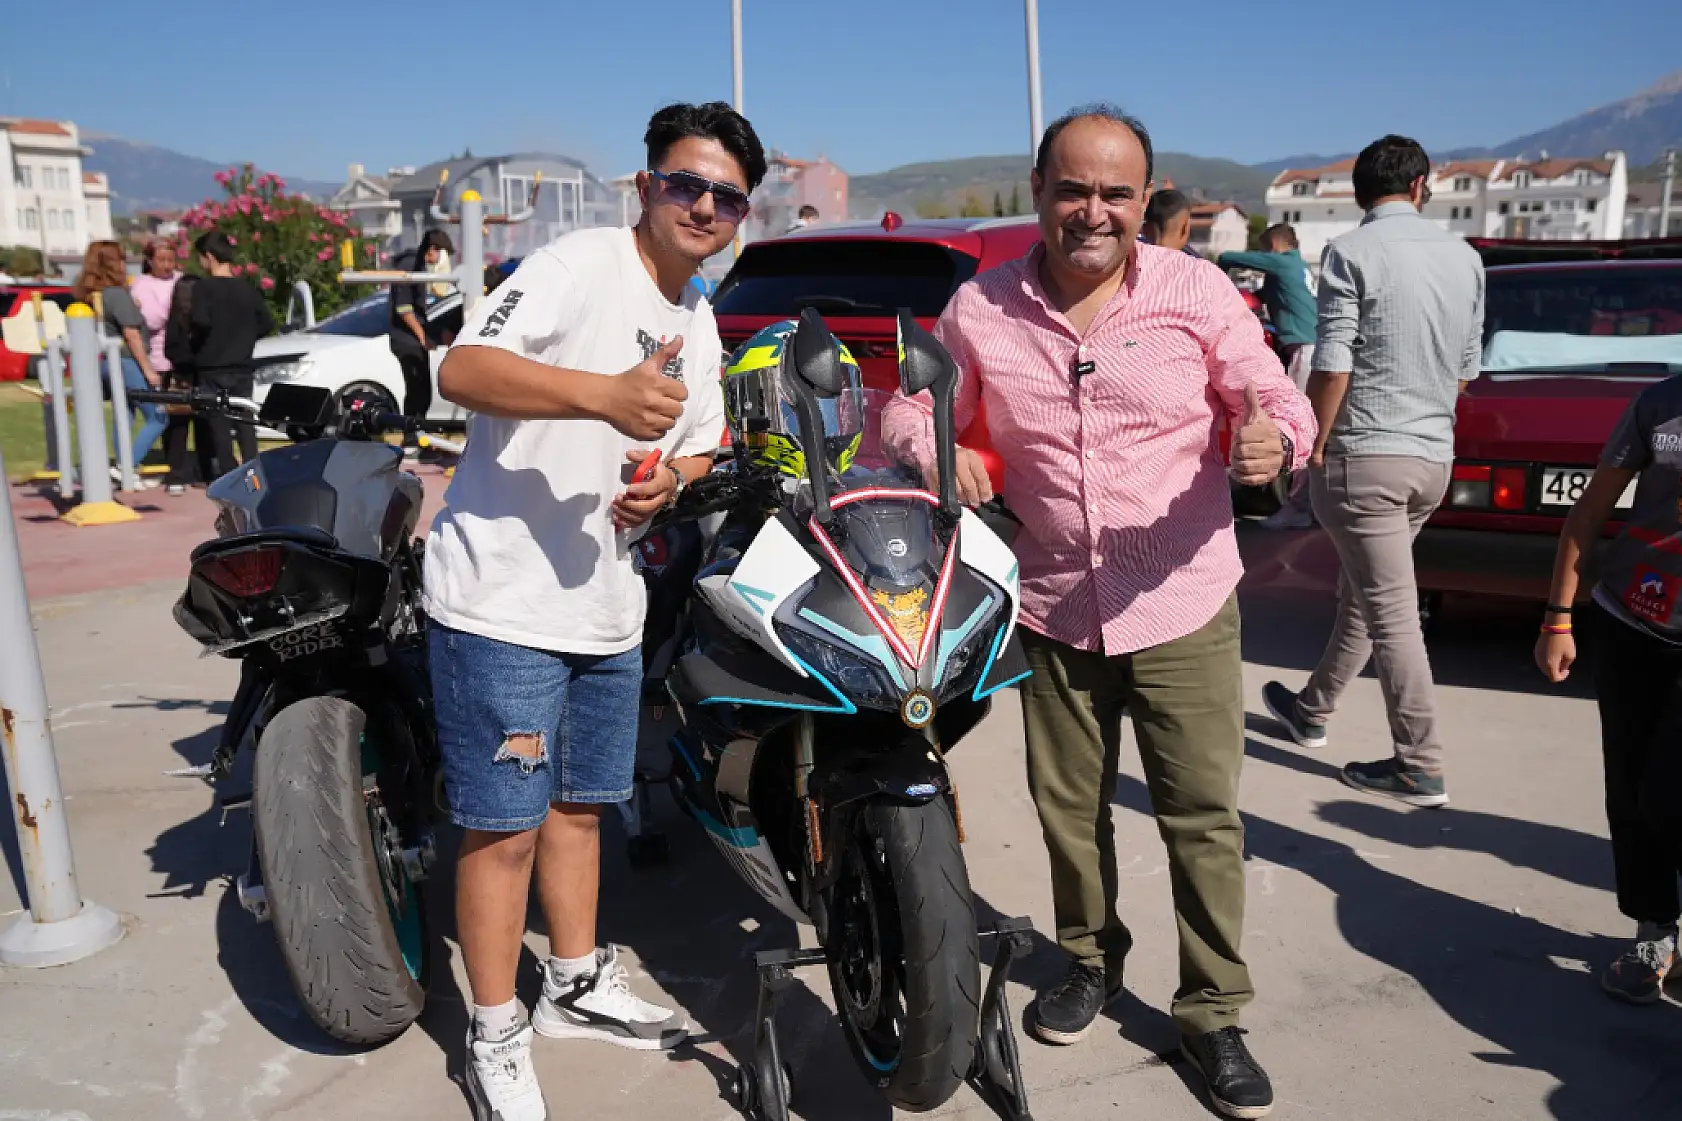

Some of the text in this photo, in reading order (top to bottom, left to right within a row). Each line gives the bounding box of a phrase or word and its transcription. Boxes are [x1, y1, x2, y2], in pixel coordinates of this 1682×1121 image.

[479, 289, 524, 337] STAR
[1546, 472, 1586, 500] 48
[269, 620, 336, 651] CORE
[276, 635, 344, 662] RIDER
